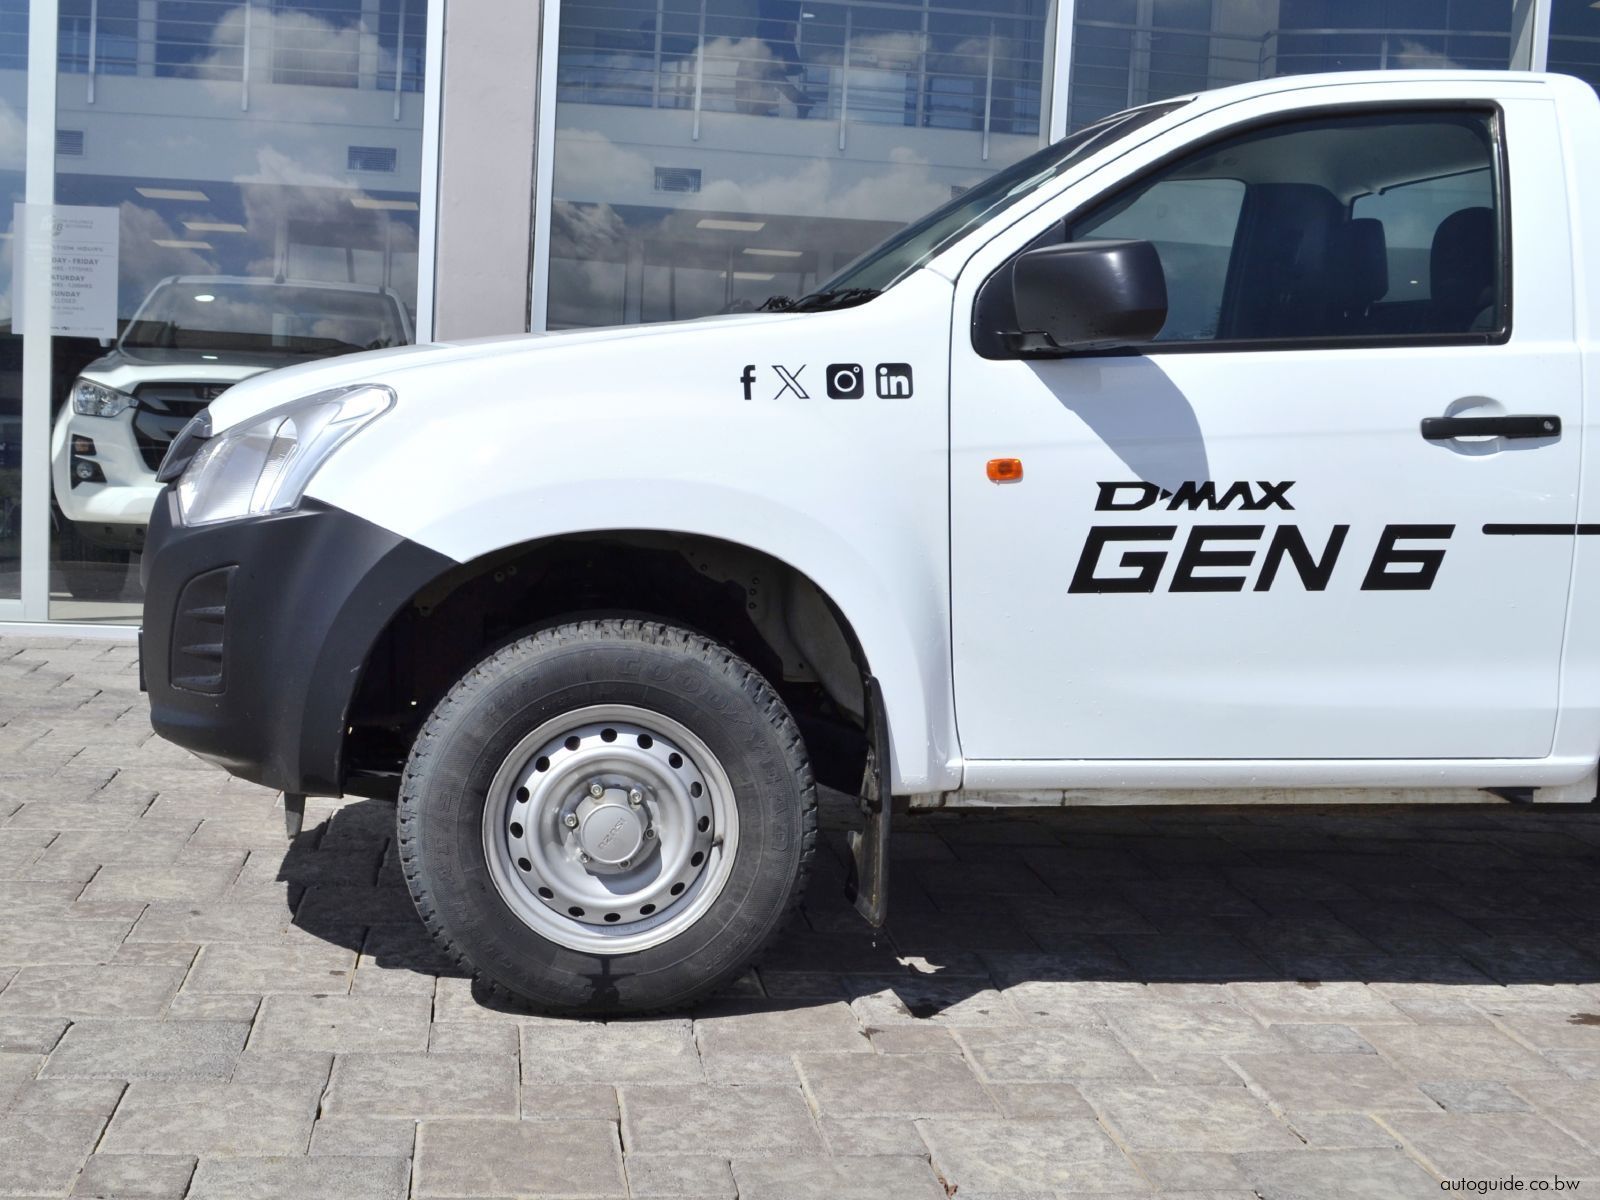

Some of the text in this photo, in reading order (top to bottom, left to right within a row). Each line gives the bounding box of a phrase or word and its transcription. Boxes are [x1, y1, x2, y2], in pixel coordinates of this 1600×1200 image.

[51, 274, 85, 282] ATURDAY
[1094, 480, 1297, 512] D-MAX
[1067, 523, 1457, 594] GEN 6
